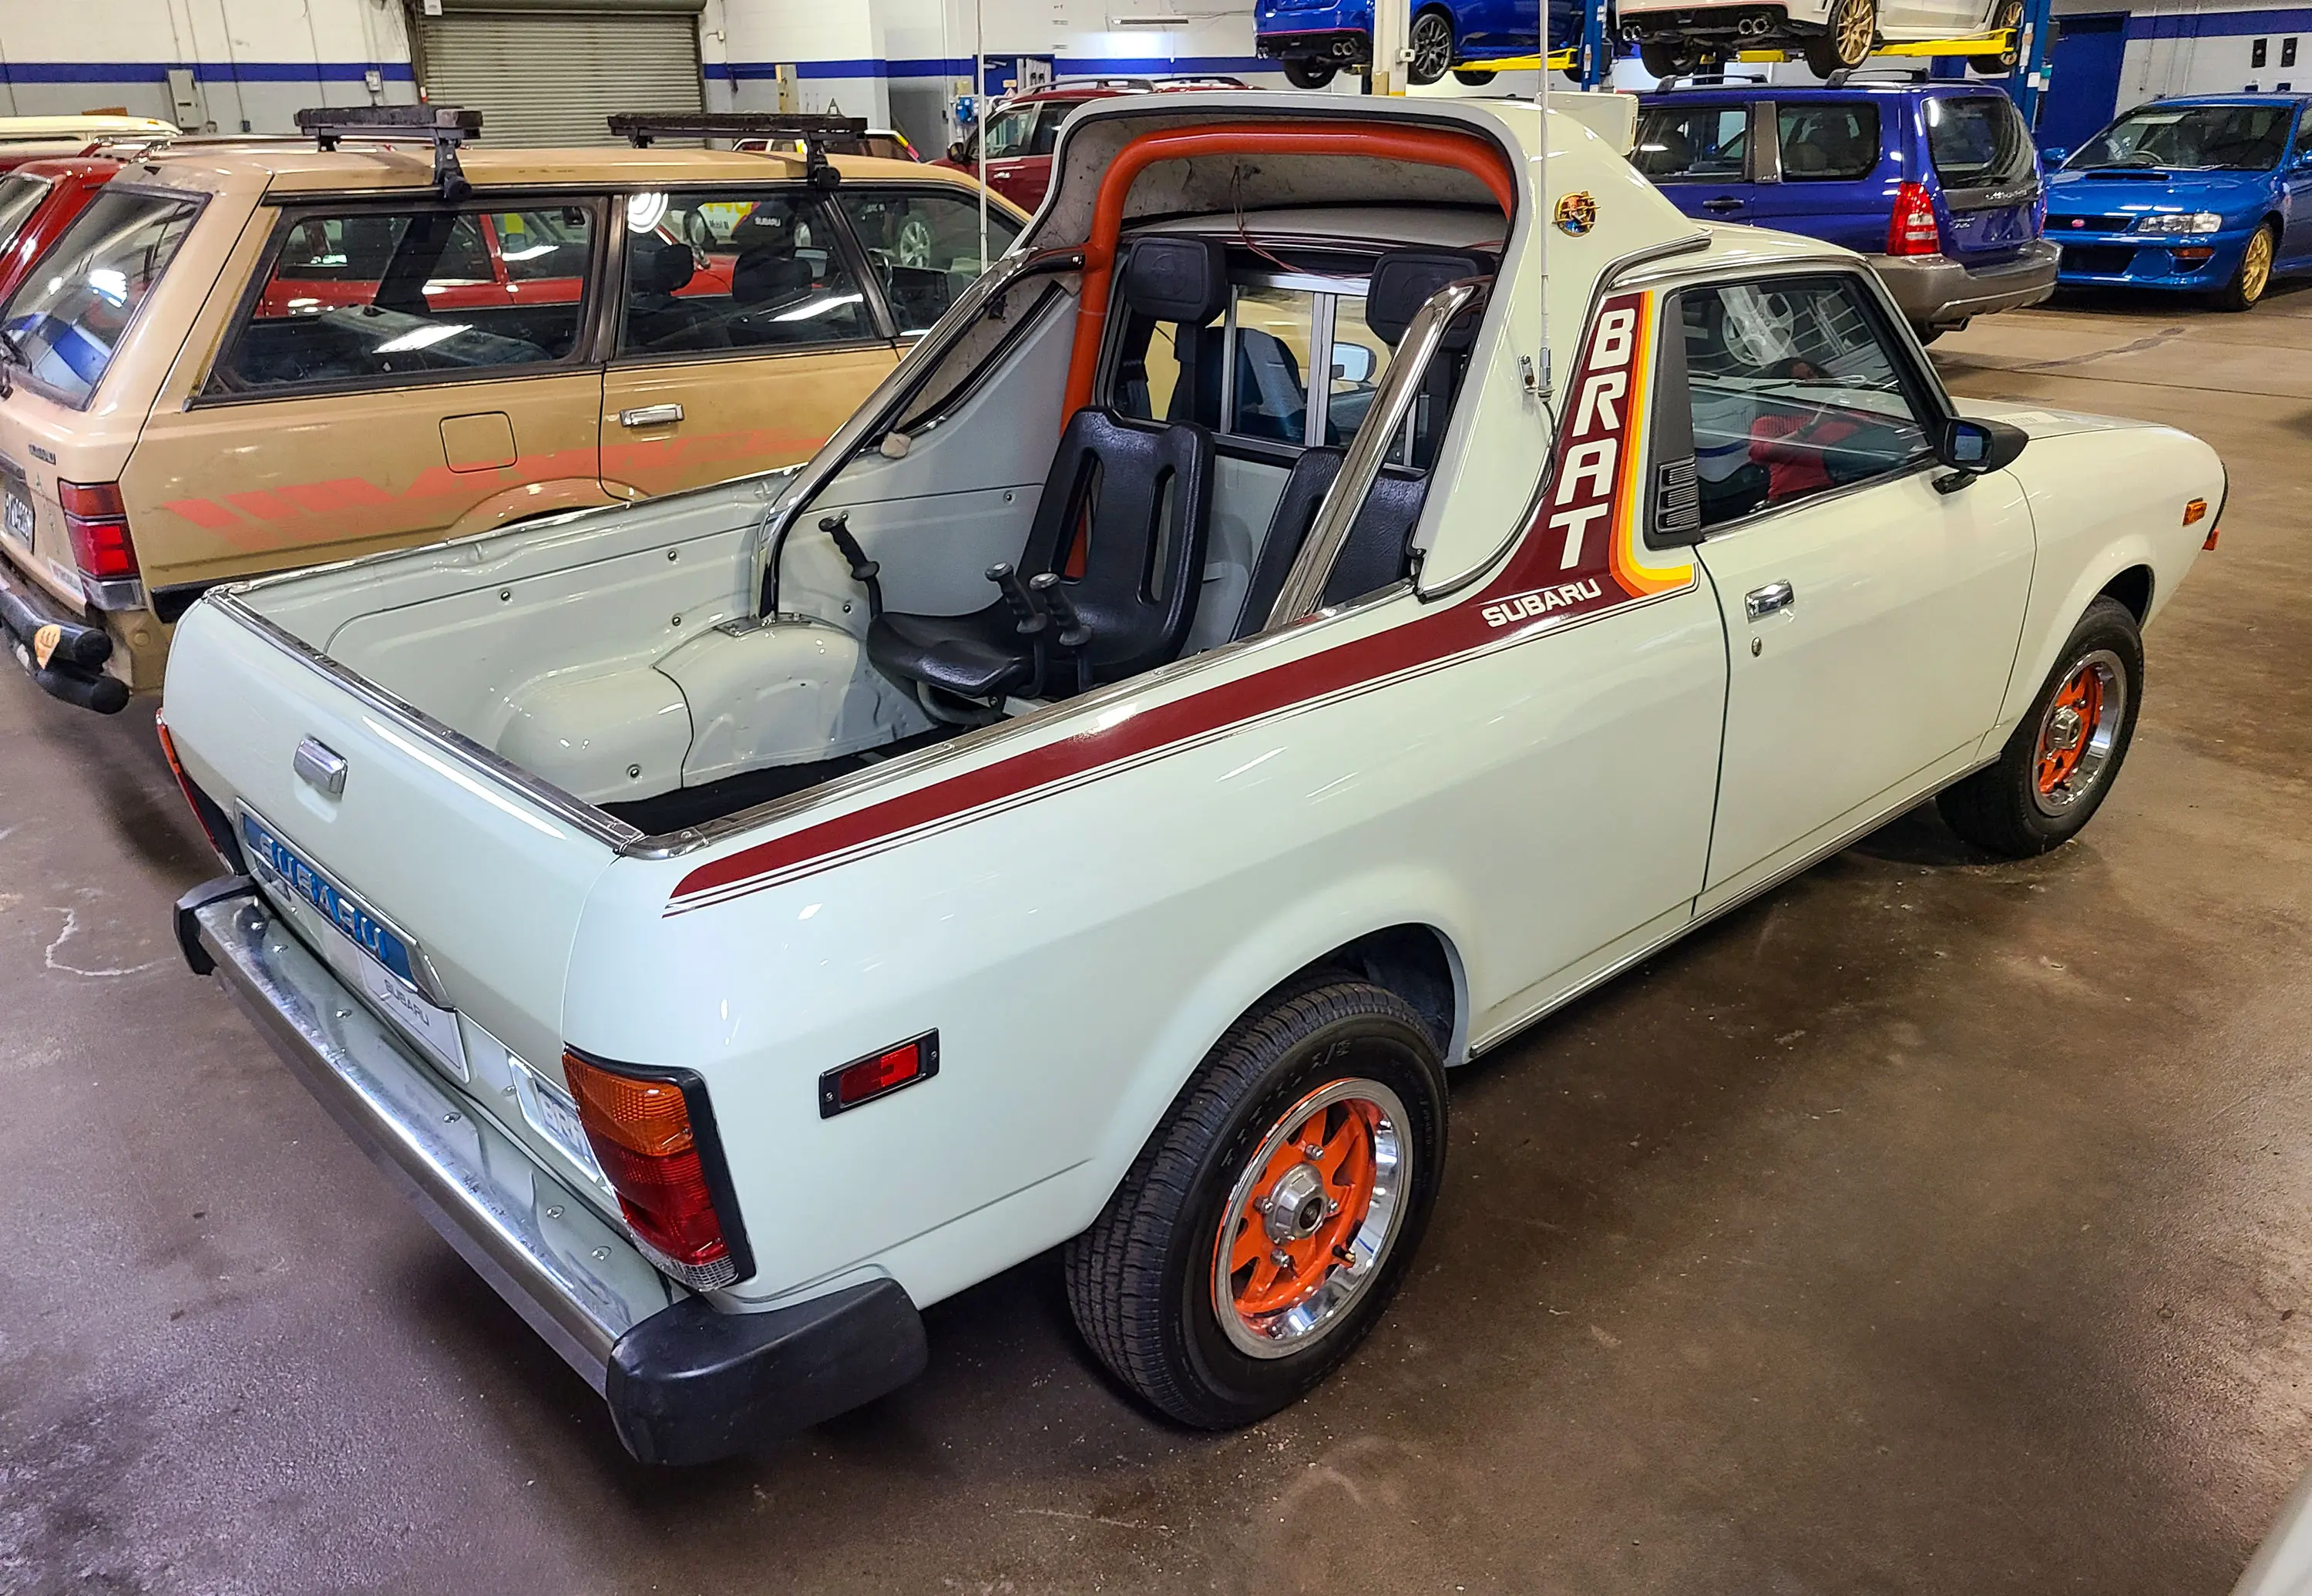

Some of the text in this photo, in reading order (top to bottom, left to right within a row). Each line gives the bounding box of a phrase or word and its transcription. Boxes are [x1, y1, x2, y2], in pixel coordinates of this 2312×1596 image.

[1548, 308, 1635, 570] BRAT
[1481, 578, 1602, 628] SUBARU
[260, 832, 386, 962] SUBARU
[384, 979, 430, 1026] SUBARU
[539, 1090, 593, 1164] BRA
